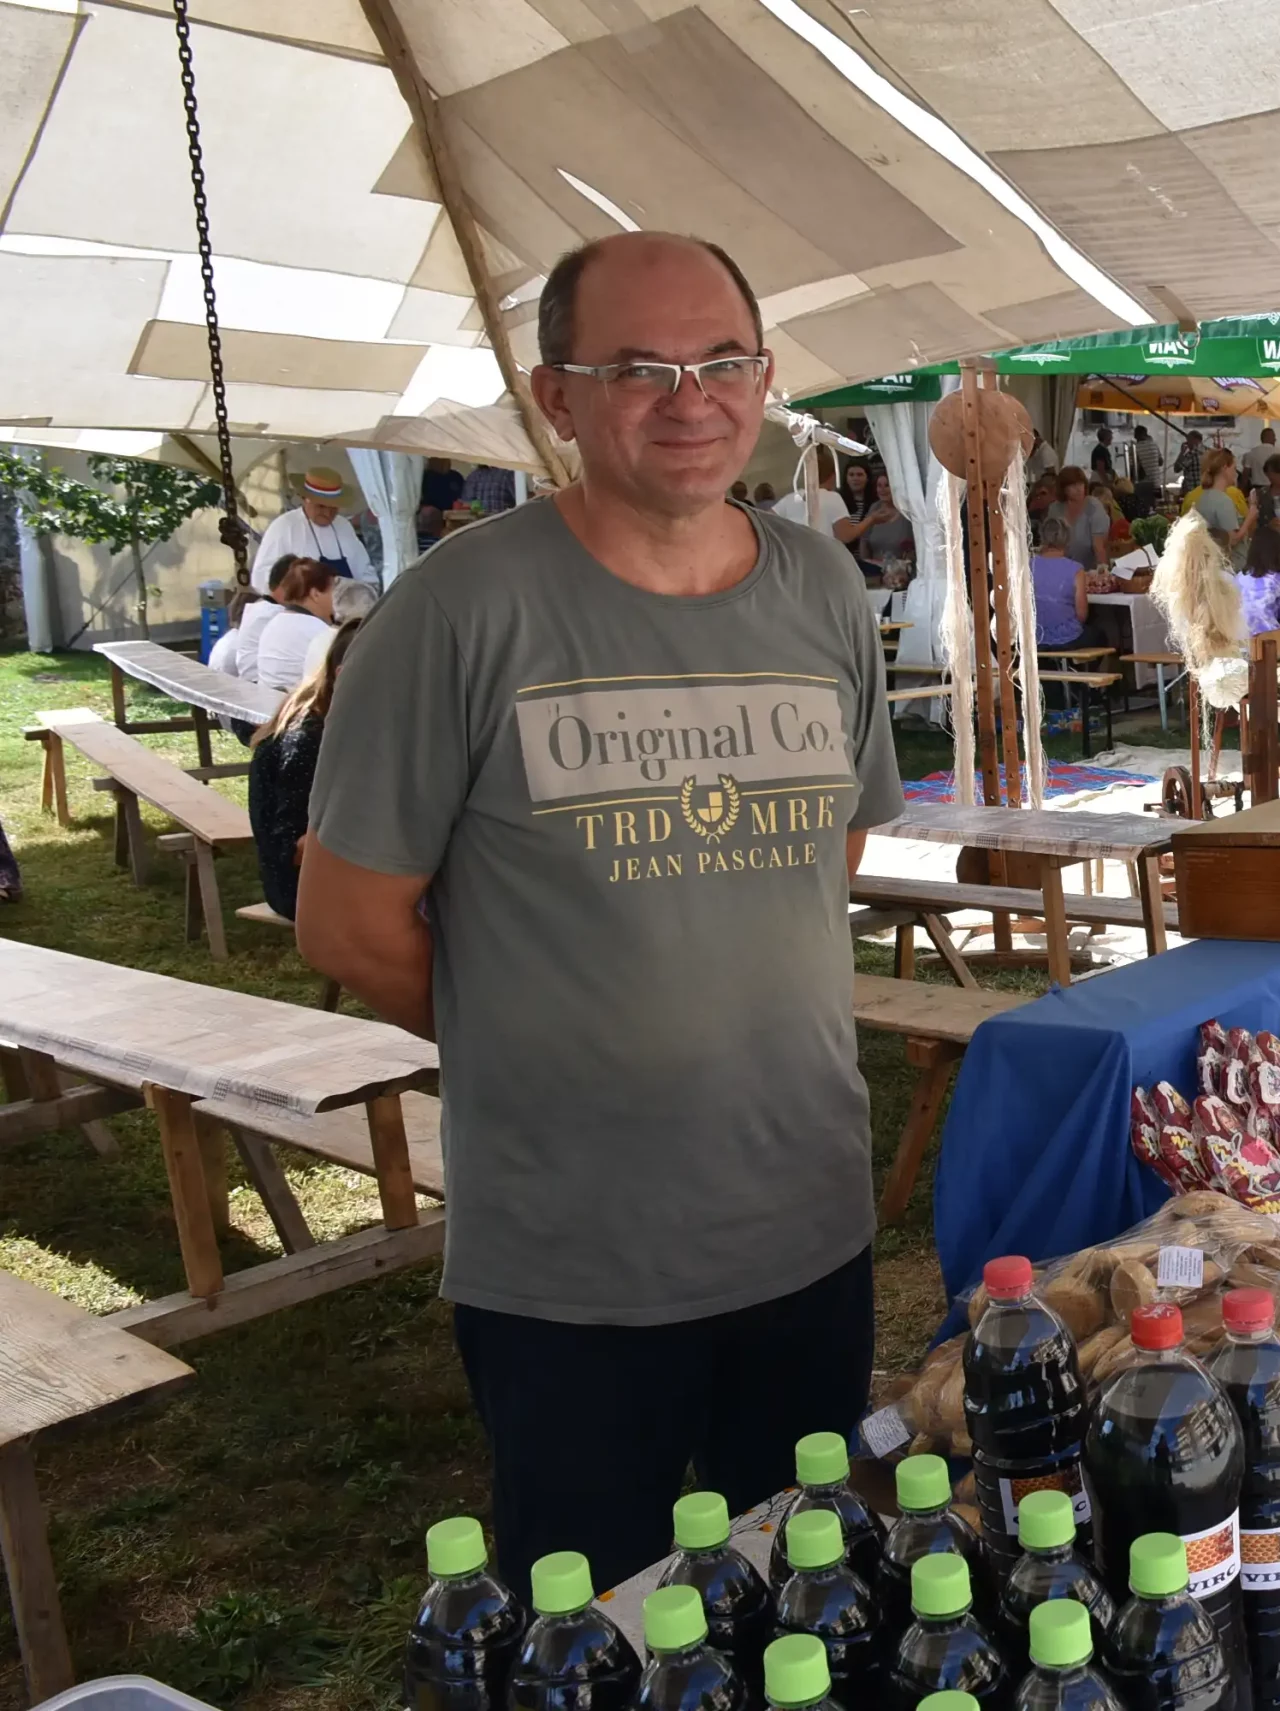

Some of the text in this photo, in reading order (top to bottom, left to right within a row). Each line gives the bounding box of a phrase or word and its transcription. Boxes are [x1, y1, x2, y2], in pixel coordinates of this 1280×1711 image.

[548, 702, 835, 782] Original Co.
[576, 808, 672, 850] TRD
[609, 842, 818, 883] JEAN PASCALE
[1186, 1563, 1236, 1593] VIRC
